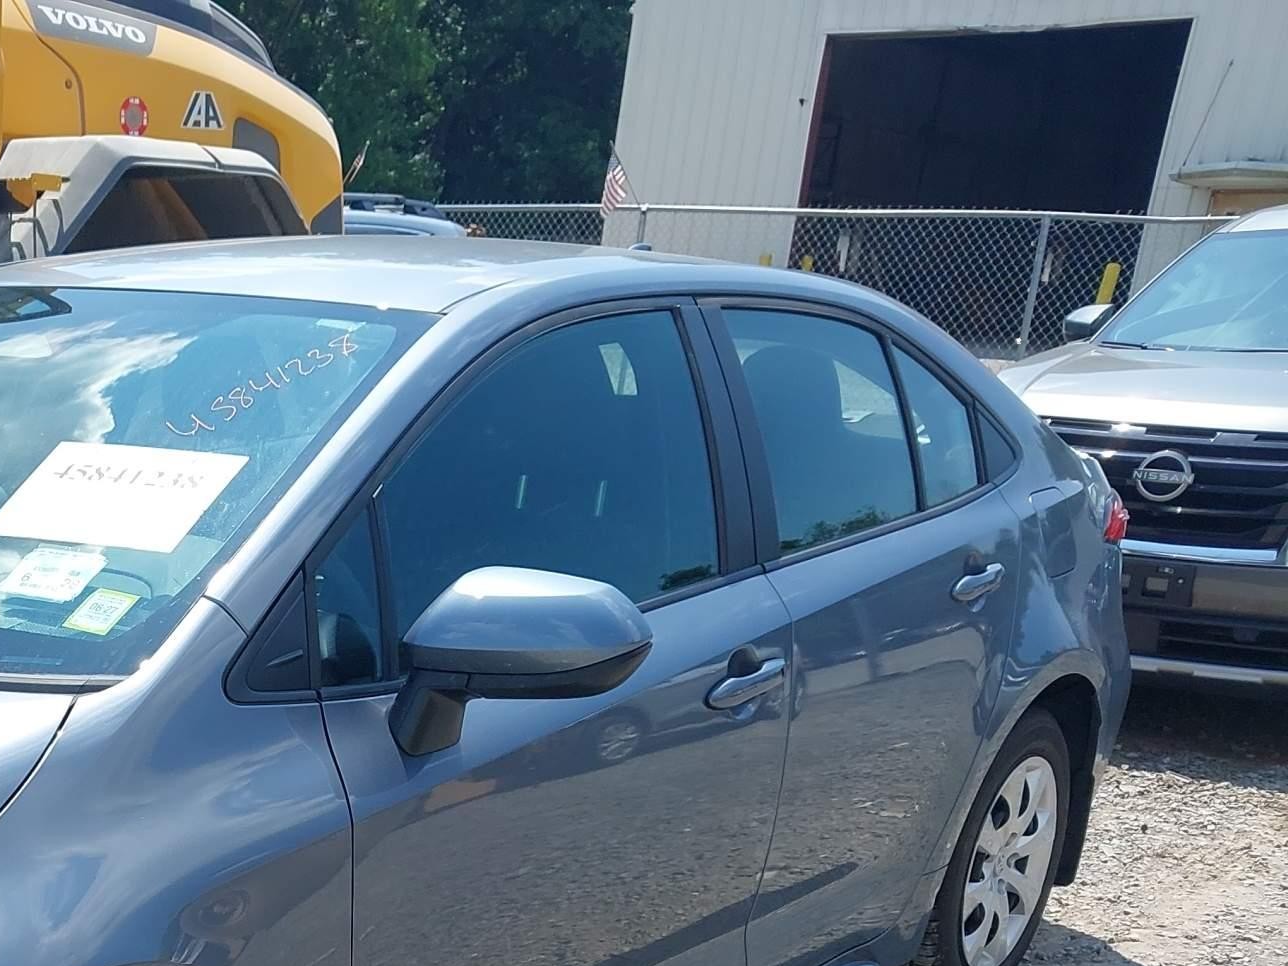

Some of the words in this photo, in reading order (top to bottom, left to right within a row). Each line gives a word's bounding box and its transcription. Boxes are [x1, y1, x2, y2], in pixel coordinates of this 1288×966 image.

[37, 5, 146, 44] VOLVO
[165, 333, 359, 436] 45841238
[53, 463, 205, 489] 45841238
[1133, 469, 1195, 485] NISSAN
